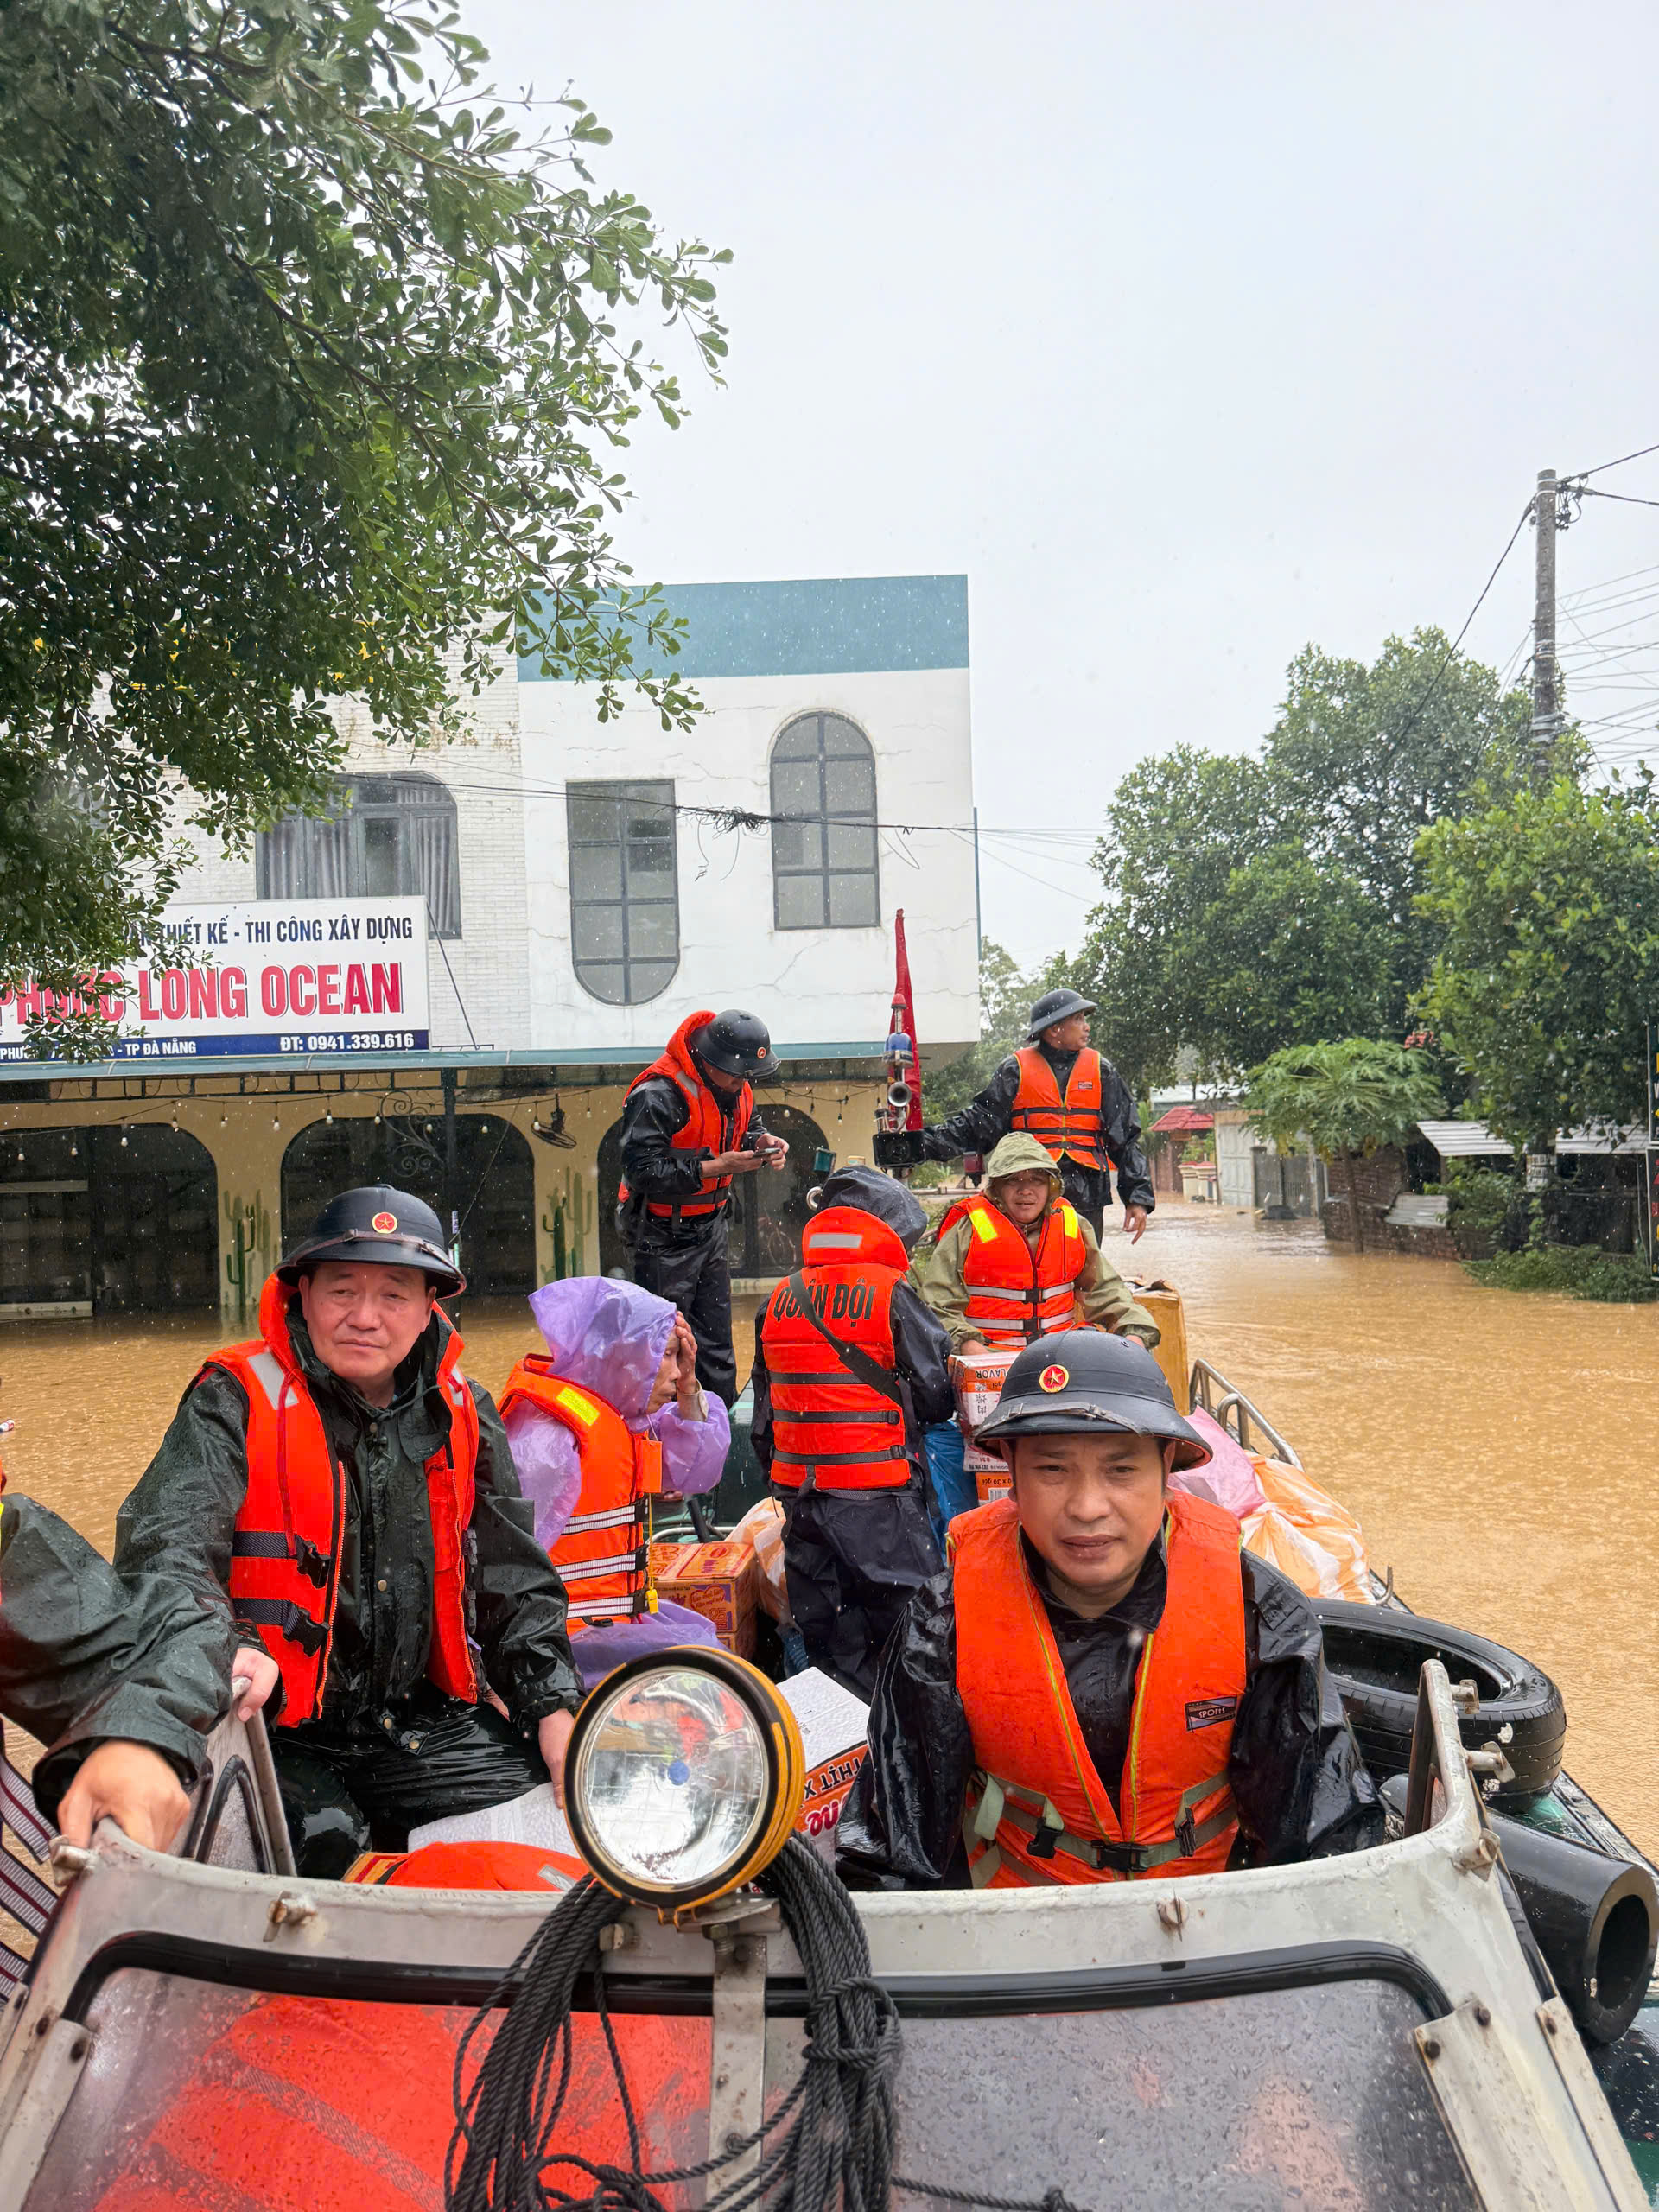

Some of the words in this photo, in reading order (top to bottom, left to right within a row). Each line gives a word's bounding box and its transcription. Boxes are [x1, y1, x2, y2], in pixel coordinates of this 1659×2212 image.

[207, 915, 229, 944] KẾ
[245, 921, 271, 943] THI
[276, 915, 323, 943] CÔNG
[328, 914, 361, 941] XÂY
[366, 915, 413, 944] DỰNG
[138, 966, 248, 1020] LONG
[261, 963, 402, 1018] OCEAN
[124, 1043, 140, 1056] TP
[143, 1039, 161, 1056] ĐÀ
[280, 1036, 303, 1052] ĐT:
[308, 1033, 415, 1051] 0941.339.616
[831, 1278, 876, 1327] ĐỘI
[975, 1368, 1007, 1380] LAVOR
[821, 1758, 861, 1792] THỊT
